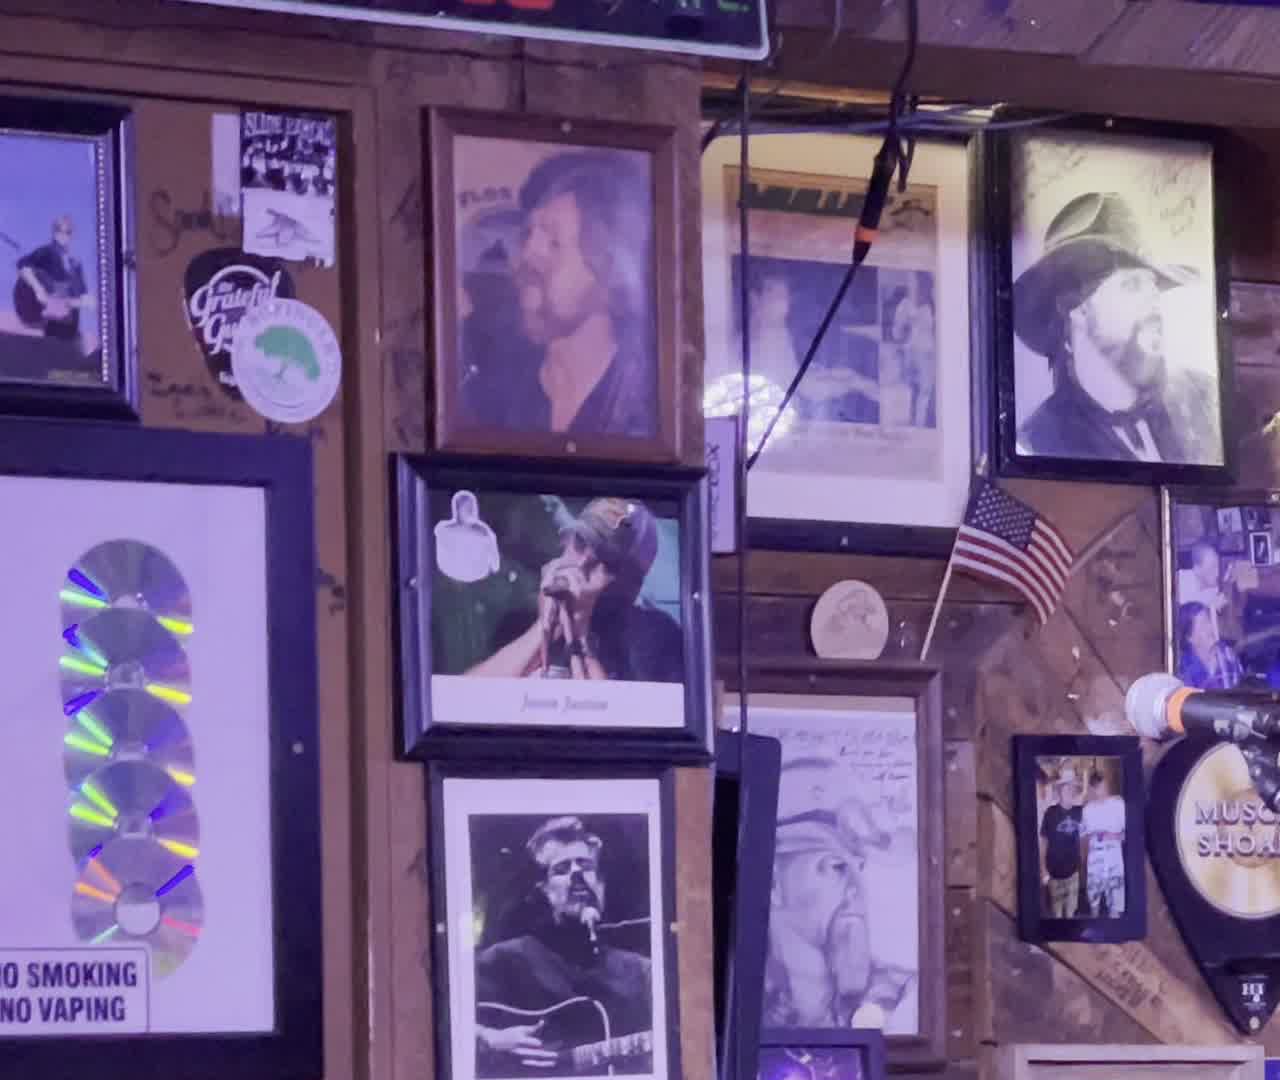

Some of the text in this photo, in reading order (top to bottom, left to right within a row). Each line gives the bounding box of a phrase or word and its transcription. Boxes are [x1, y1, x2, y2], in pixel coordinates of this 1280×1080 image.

[27, 962, 137, 989] SMOKING
[0, 996, 126, 1023] NO VAPING
